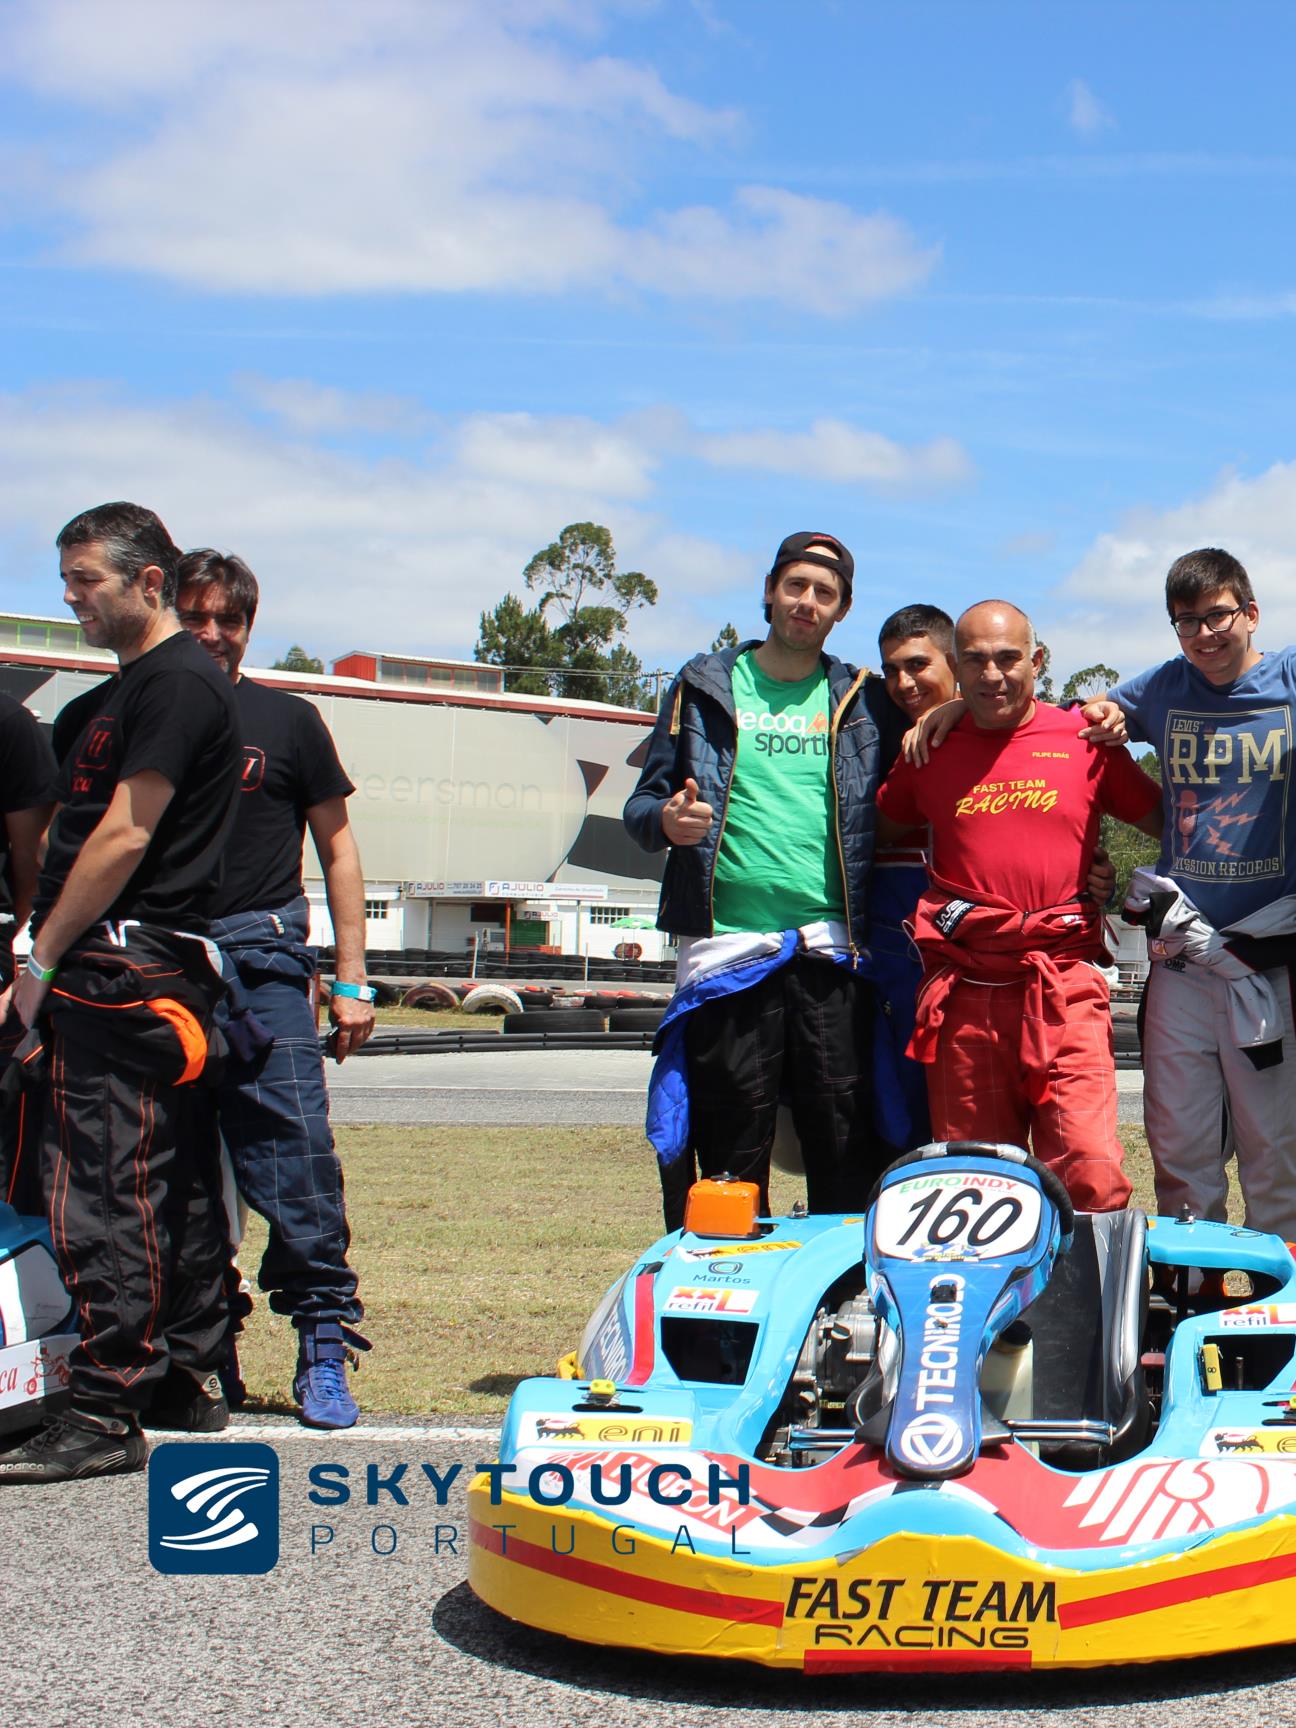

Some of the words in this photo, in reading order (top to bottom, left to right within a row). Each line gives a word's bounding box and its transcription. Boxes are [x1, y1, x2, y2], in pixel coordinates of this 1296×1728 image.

[754, 733, 827, 757] sporti
[1168, 728, 1287, 784] RPM
[350, 762, 543, 811] teersman
[973, 782, 1005, 794] FAST
[1009, 779, 1046, 790] TEAM
[955, 789, 1059, 817] RACING
[1219, 857, 1280, 876] RECORDS
[898, 1176, 1019, 1194] EUROINDY
[896, 1187, 1023, 1247] 160
[692, 1273, 751, 1285] Martos
[668, 1301, 714, 1311] refil
[1223, 1316, 1267, 1327] refil
[598, 1421, 681, 1442] eni
[785, 1576, 906, 1621] FAST
[922, 1579, 1057, 1623] TEAM
[815, 1624, 1029, 1649] RACING
